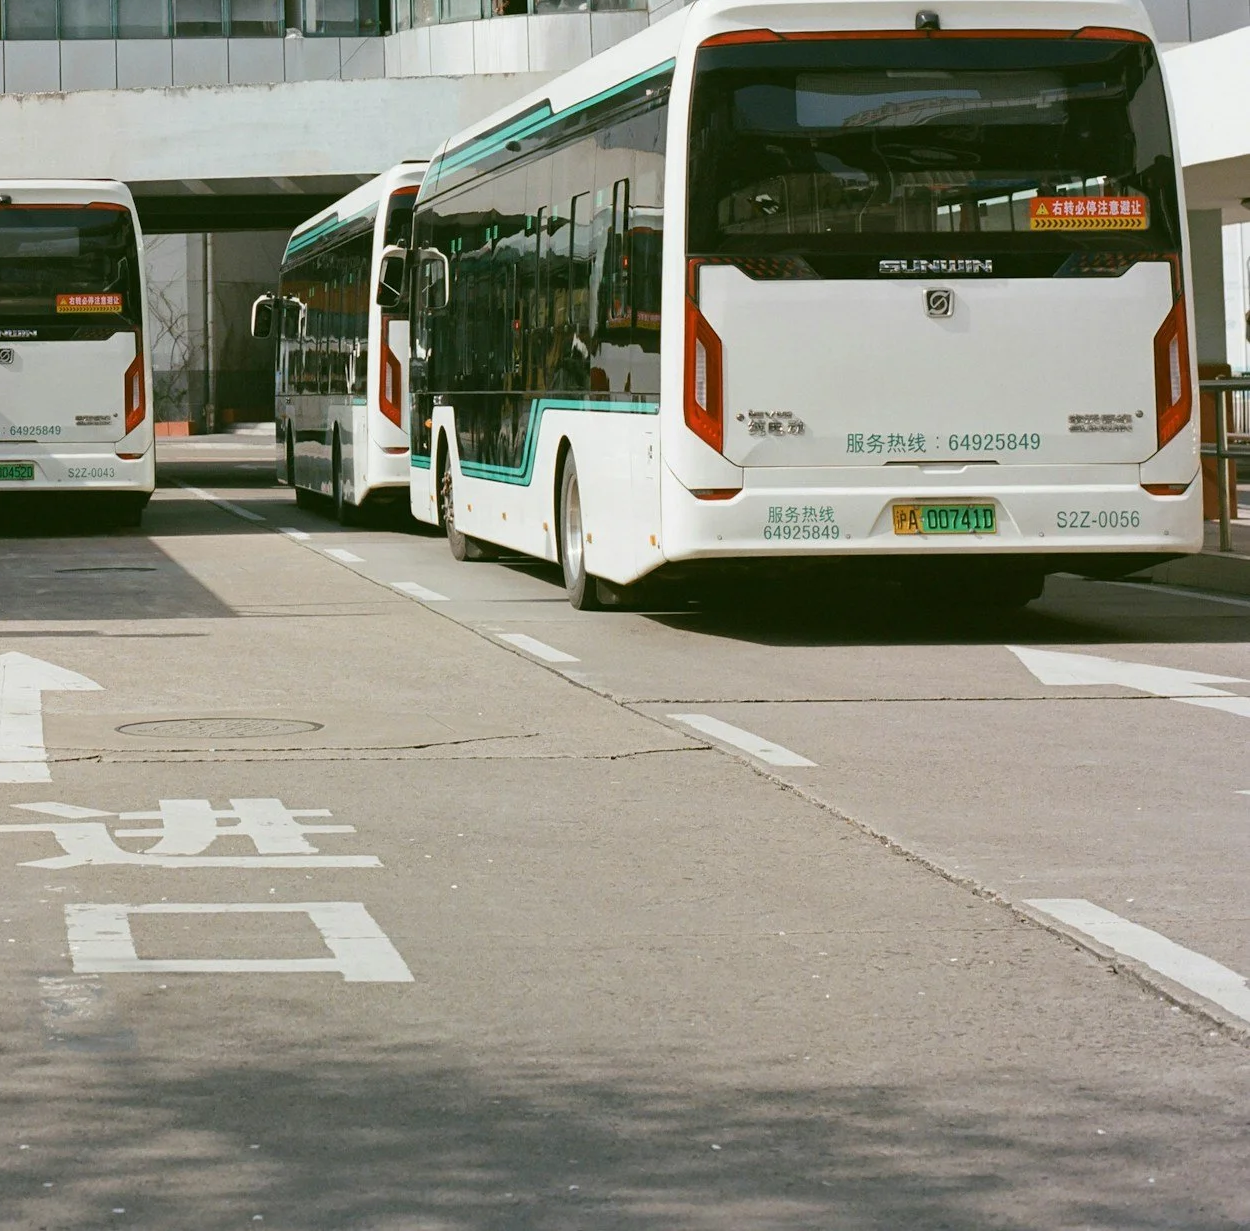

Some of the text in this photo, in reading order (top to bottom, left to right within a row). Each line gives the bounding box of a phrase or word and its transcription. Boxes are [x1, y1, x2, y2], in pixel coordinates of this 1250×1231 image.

[1052, 200, 1141, 215] 右转必停注意避让
[879, 259, 993, 273] SUNWIN
[69, 296, 120, 305] 右转必停注意避让
[68, 468, 115, 479] S2Z-0043
[767, 506, 835, 524] 服务热线
[1056, 511, 1141, 529] S2Z-0056
[763, 525, 840, 540] 64925849
